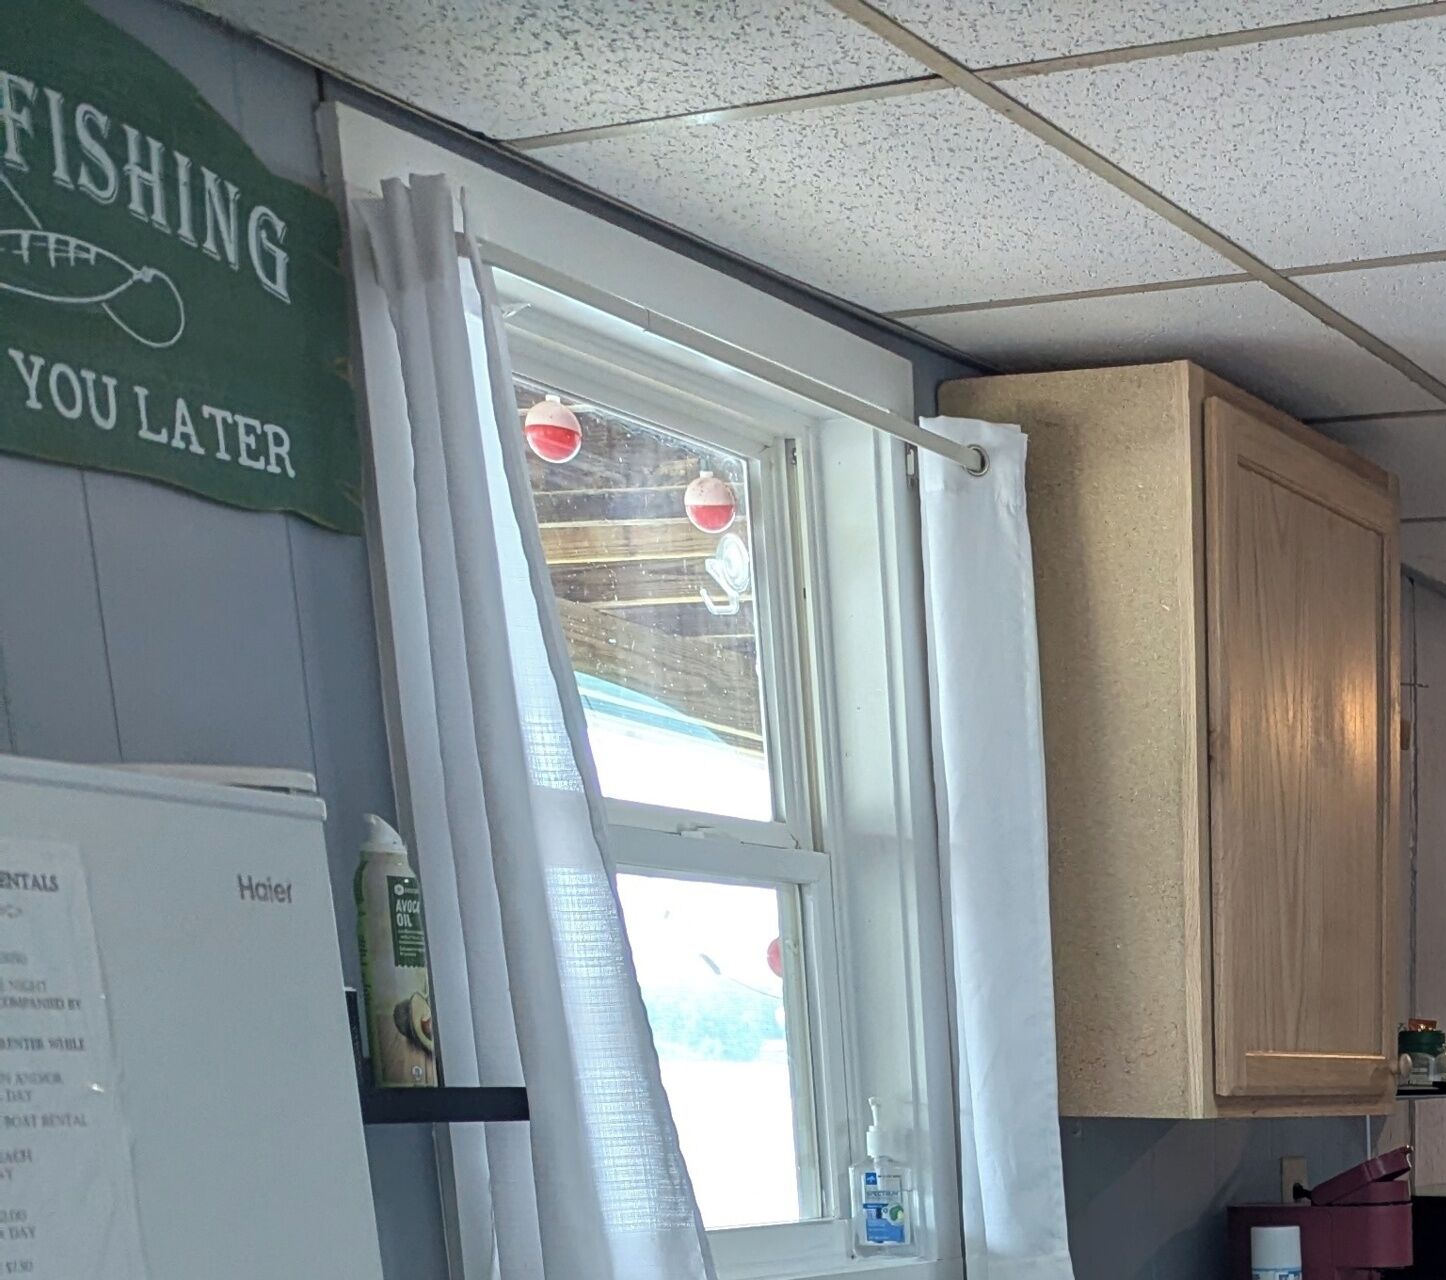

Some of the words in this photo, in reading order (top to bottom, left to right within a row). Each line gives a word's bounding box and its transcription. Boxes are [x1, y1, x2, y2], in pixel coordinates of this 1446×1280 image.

[0, 70, 292, 305] FISHING
[9, 348, 118, 431] YOU
[133, 385, 296, 479] LATER
[238, 874, 293, 904] Haier
[396, 913, 412, 927] OIL
[6, 1088, 32, 1103] DAY
[42, 1113, 87, 1128] RENTAL
[8, 1225, 36, 1241] DAY
